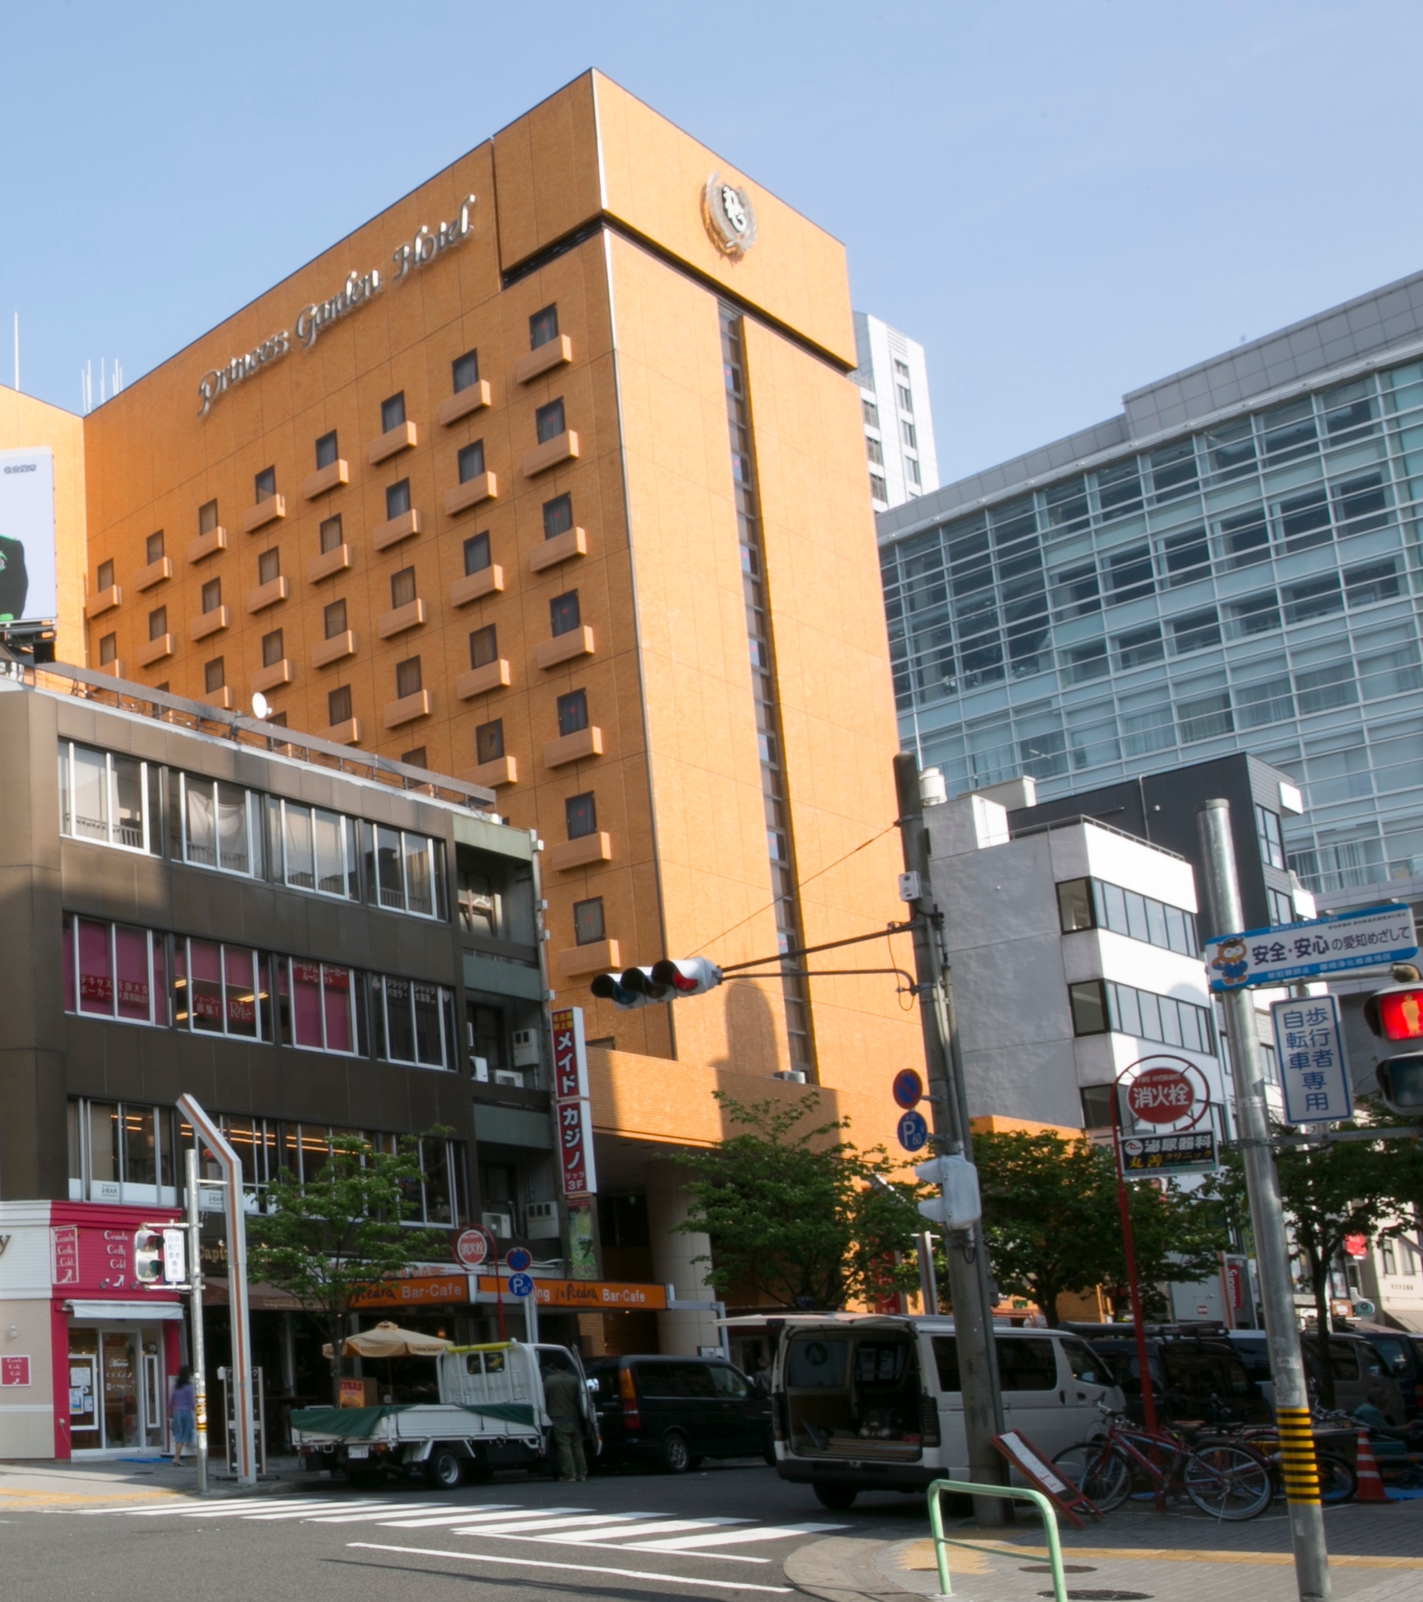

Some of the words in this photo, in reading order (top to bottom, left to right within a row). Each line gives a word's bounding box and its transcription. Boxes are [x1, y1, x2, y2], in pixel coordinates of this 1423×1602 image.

[197, 330, 290, 417] Princess
[295, 270, 383, 349] Garden
[391, 194, 475, 282] Hotel
[556, 1031, 576, 1095] メイド
[1283, 1010, 1312, 1071] 自転車
[1306, 1007, 1333, 1068] 歩行者
[1133, 1083, 1189, 1109] 消火栓
[1302, 1072, 1330, 1112] 専用
[562, 1108, 581, 1171] カジノ
[902, 1120, 916, 1147] P
[567, 1180, 584, 1191] 3F
